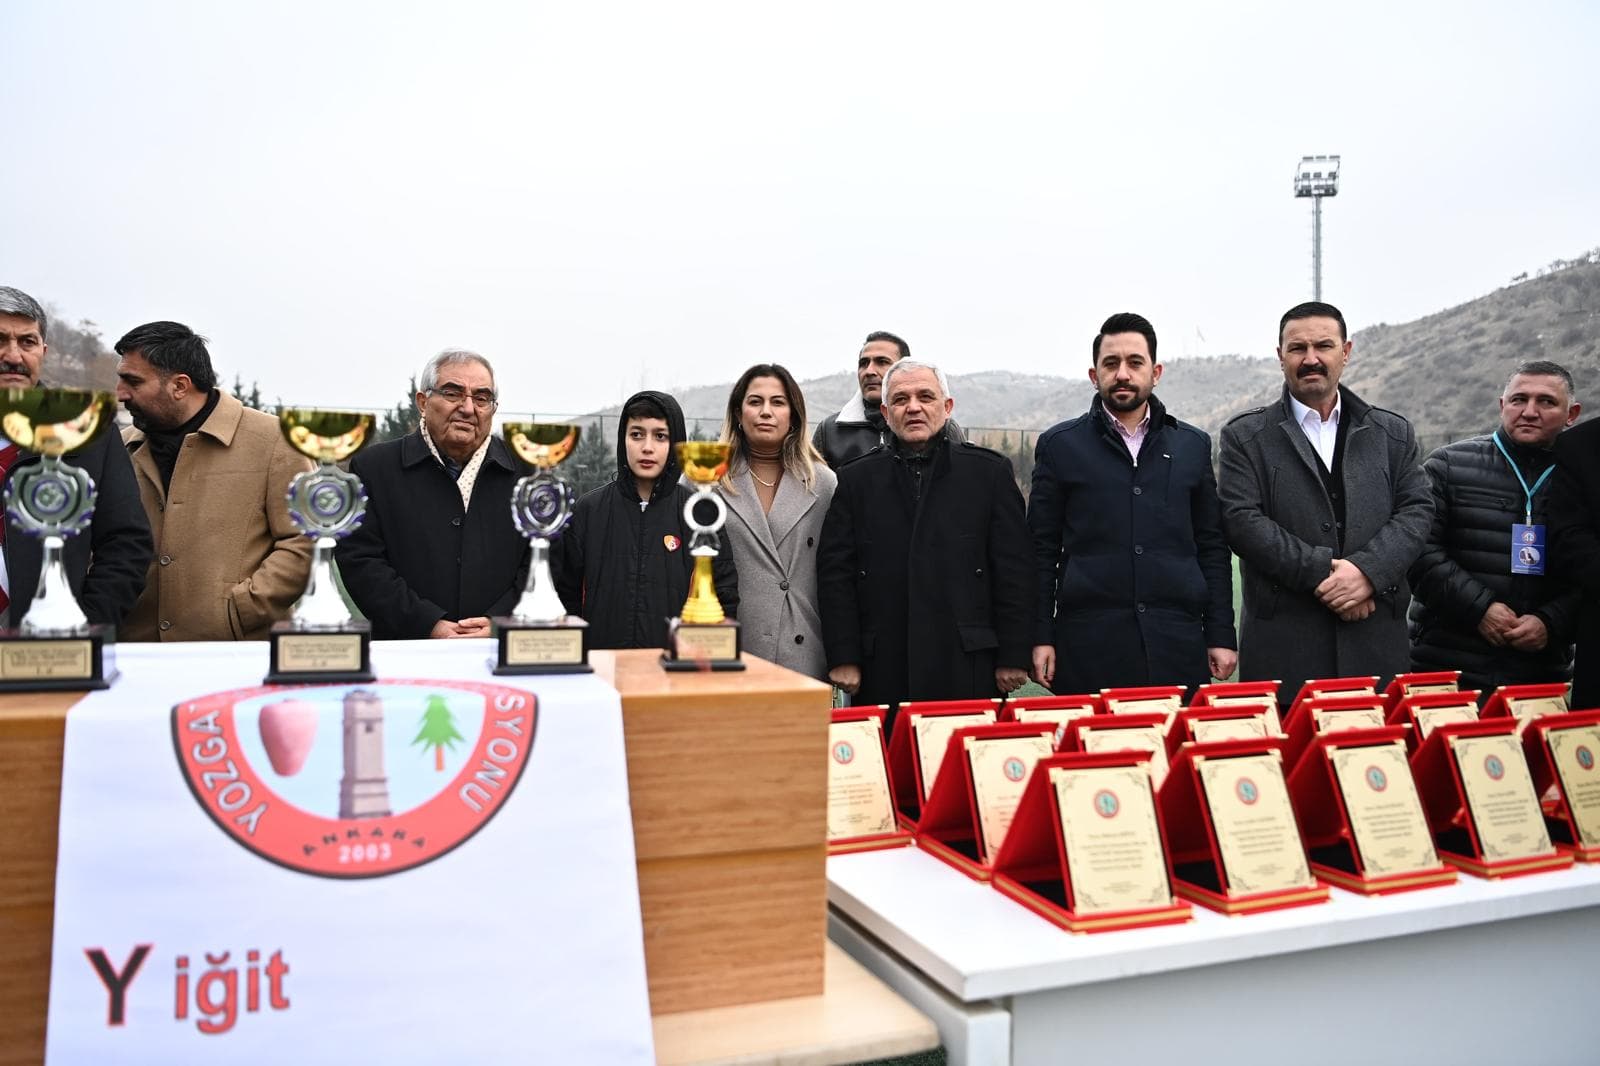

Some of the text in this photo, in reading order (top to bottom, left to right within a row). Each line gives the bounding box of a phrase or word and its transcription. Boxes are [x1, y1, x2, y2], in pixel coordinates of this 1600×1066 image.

[187, 703, 268, 836] YOZGA
[459, 692, 527, 814] SYONU
[338, 842, 392, 864] 2003
